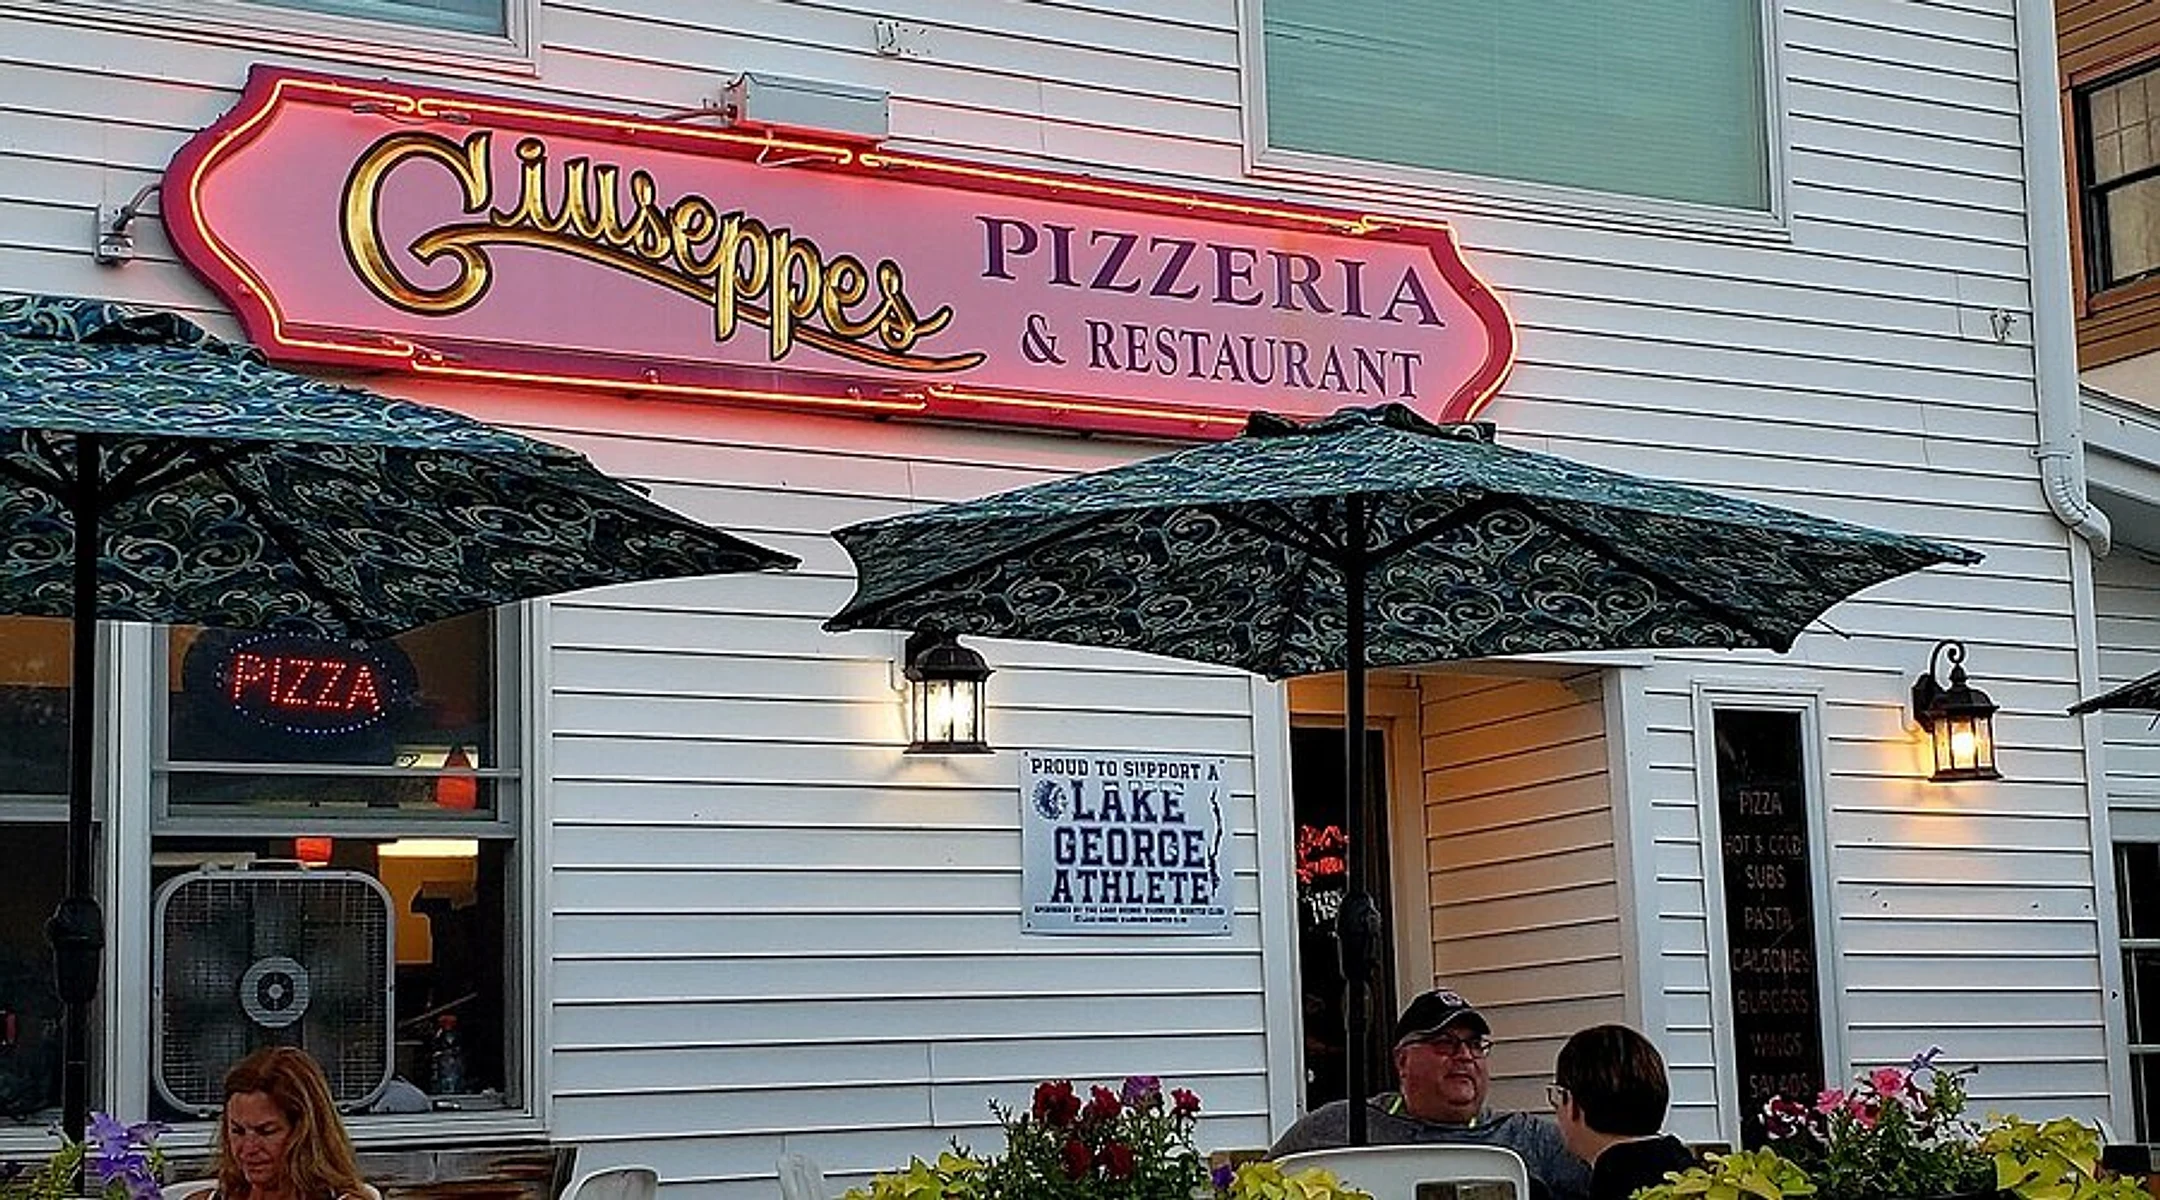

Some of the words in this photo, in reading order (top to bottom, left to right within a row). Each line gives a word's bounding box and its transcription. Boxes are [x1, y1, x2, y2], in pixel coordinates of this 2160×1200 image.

[975, 215, 1445, 327] PIZZERIA
[1021, 314, 1065, 366] &
[1086, 318, 1422, 399] RESTAURANT
[233, 653, 382, 712] PIZZA
[1031, 758, 1089, 776] PROUD
[1095, 760, 1118, 777] TO
[1124, 761, 1201, 780] SUPPORT
[1207, 764, 1219, 781] A
[1071, 779, 1185, 824] LAKE
[1739, 790, 1784, 815] PIZZA
[1054, 826, 1207, 869] GEORGE
[1051, 868, 1210, 905] ATHLETE
[1745, 863, 1787, 890] SUBS
[1744, 906, 1794, 931] PASTA
